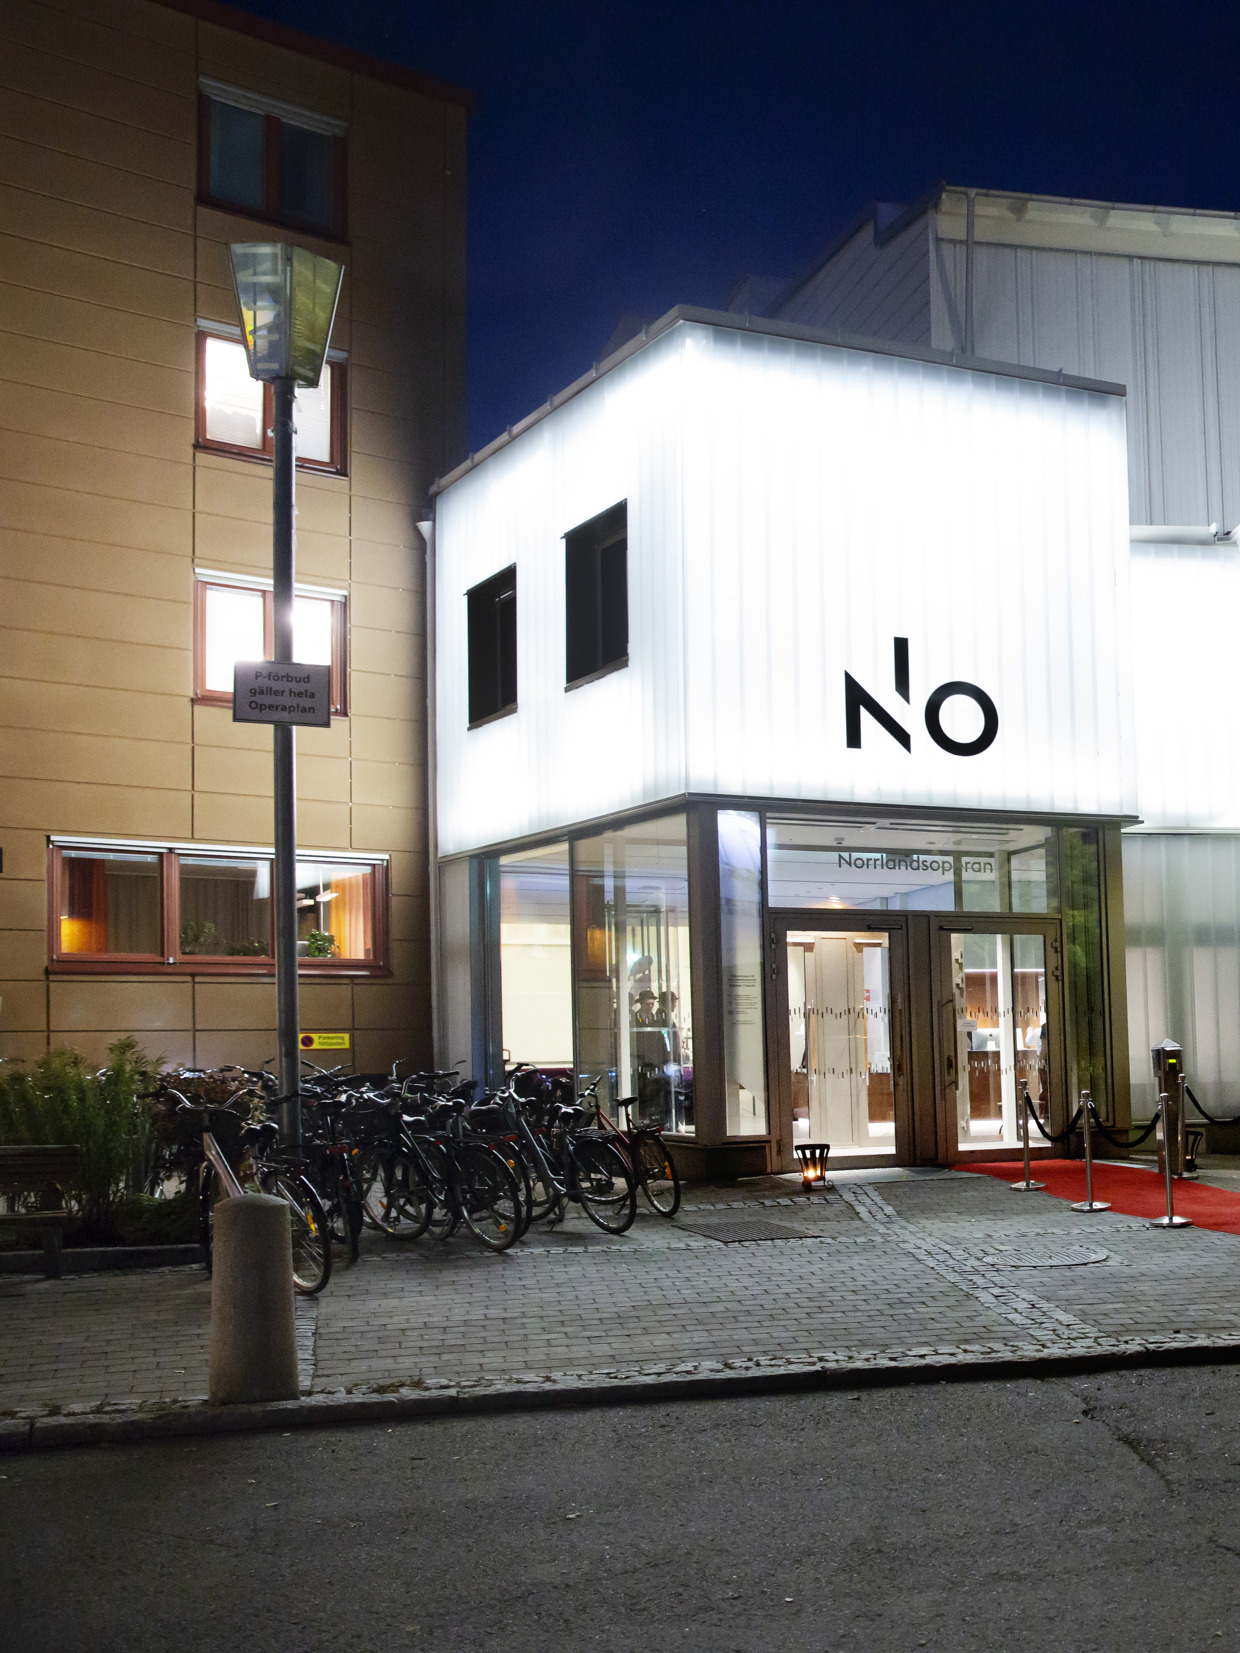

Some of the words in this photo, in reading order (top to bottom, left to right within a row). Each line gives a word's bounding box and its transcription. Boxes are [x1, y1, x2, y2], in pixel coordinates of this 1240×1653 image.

[255, 671, 311, 684] P-förbud
[249, 686, 285, 698] gäller
[289, 688, 316, 699] hela
[248, 701, 316, 714] Operaplan
[838, 852, 994, 876] Norrlandsopran
